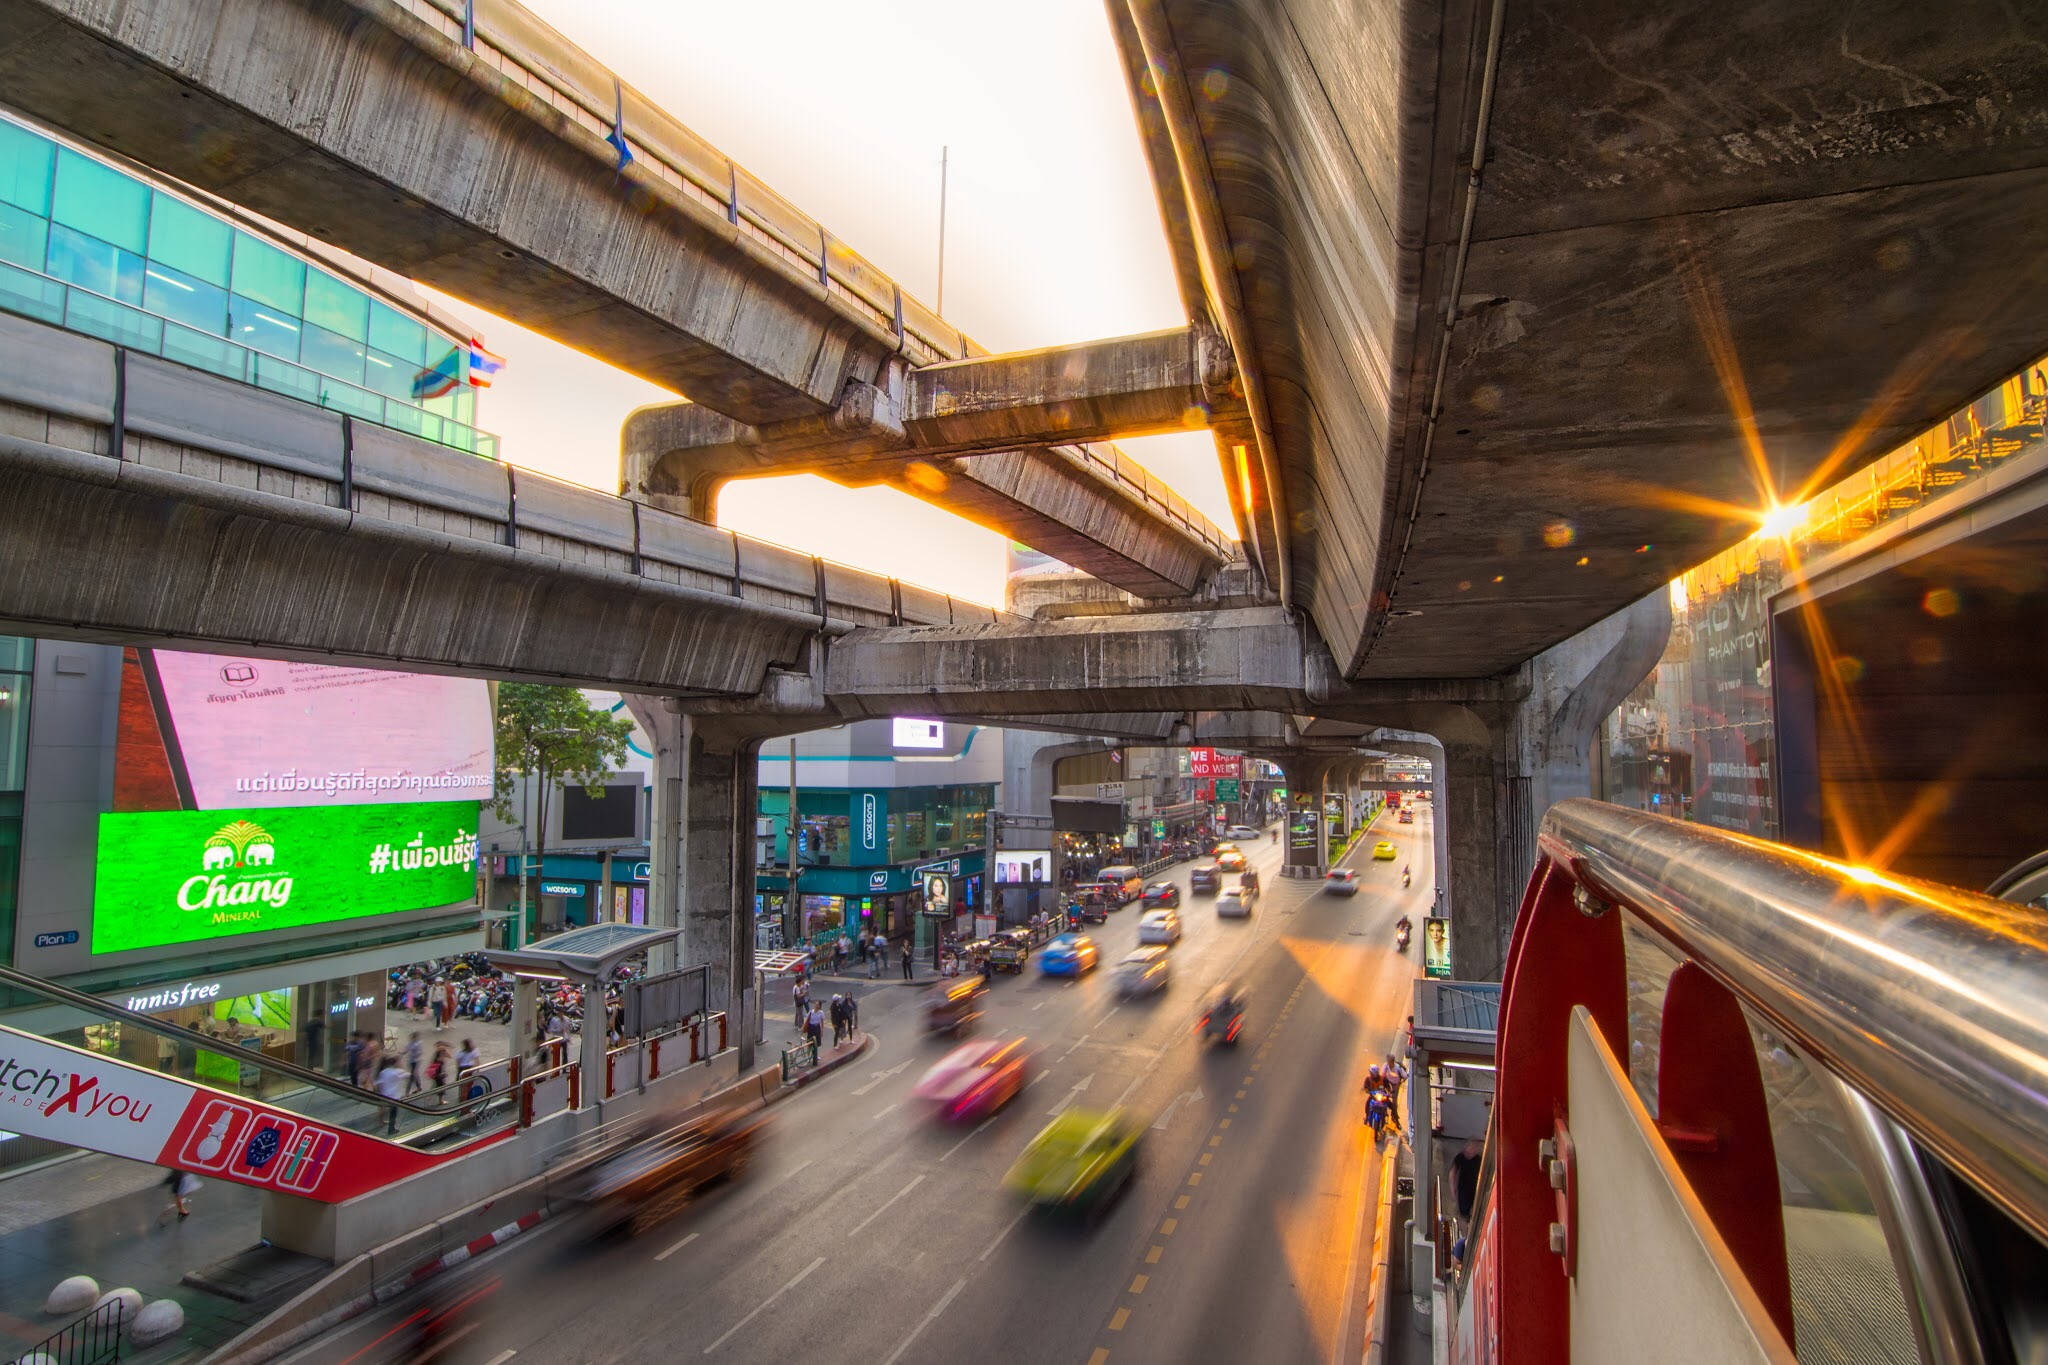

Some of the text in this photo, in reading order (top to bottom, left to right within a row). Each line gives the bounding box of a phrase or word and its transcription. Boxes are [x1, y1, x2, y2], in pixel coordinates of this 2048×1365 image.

[176, 874, 294, 911] Chang
[546, 885, 578, 895] watsons
[127, 983, 221, 1012] innisfree
